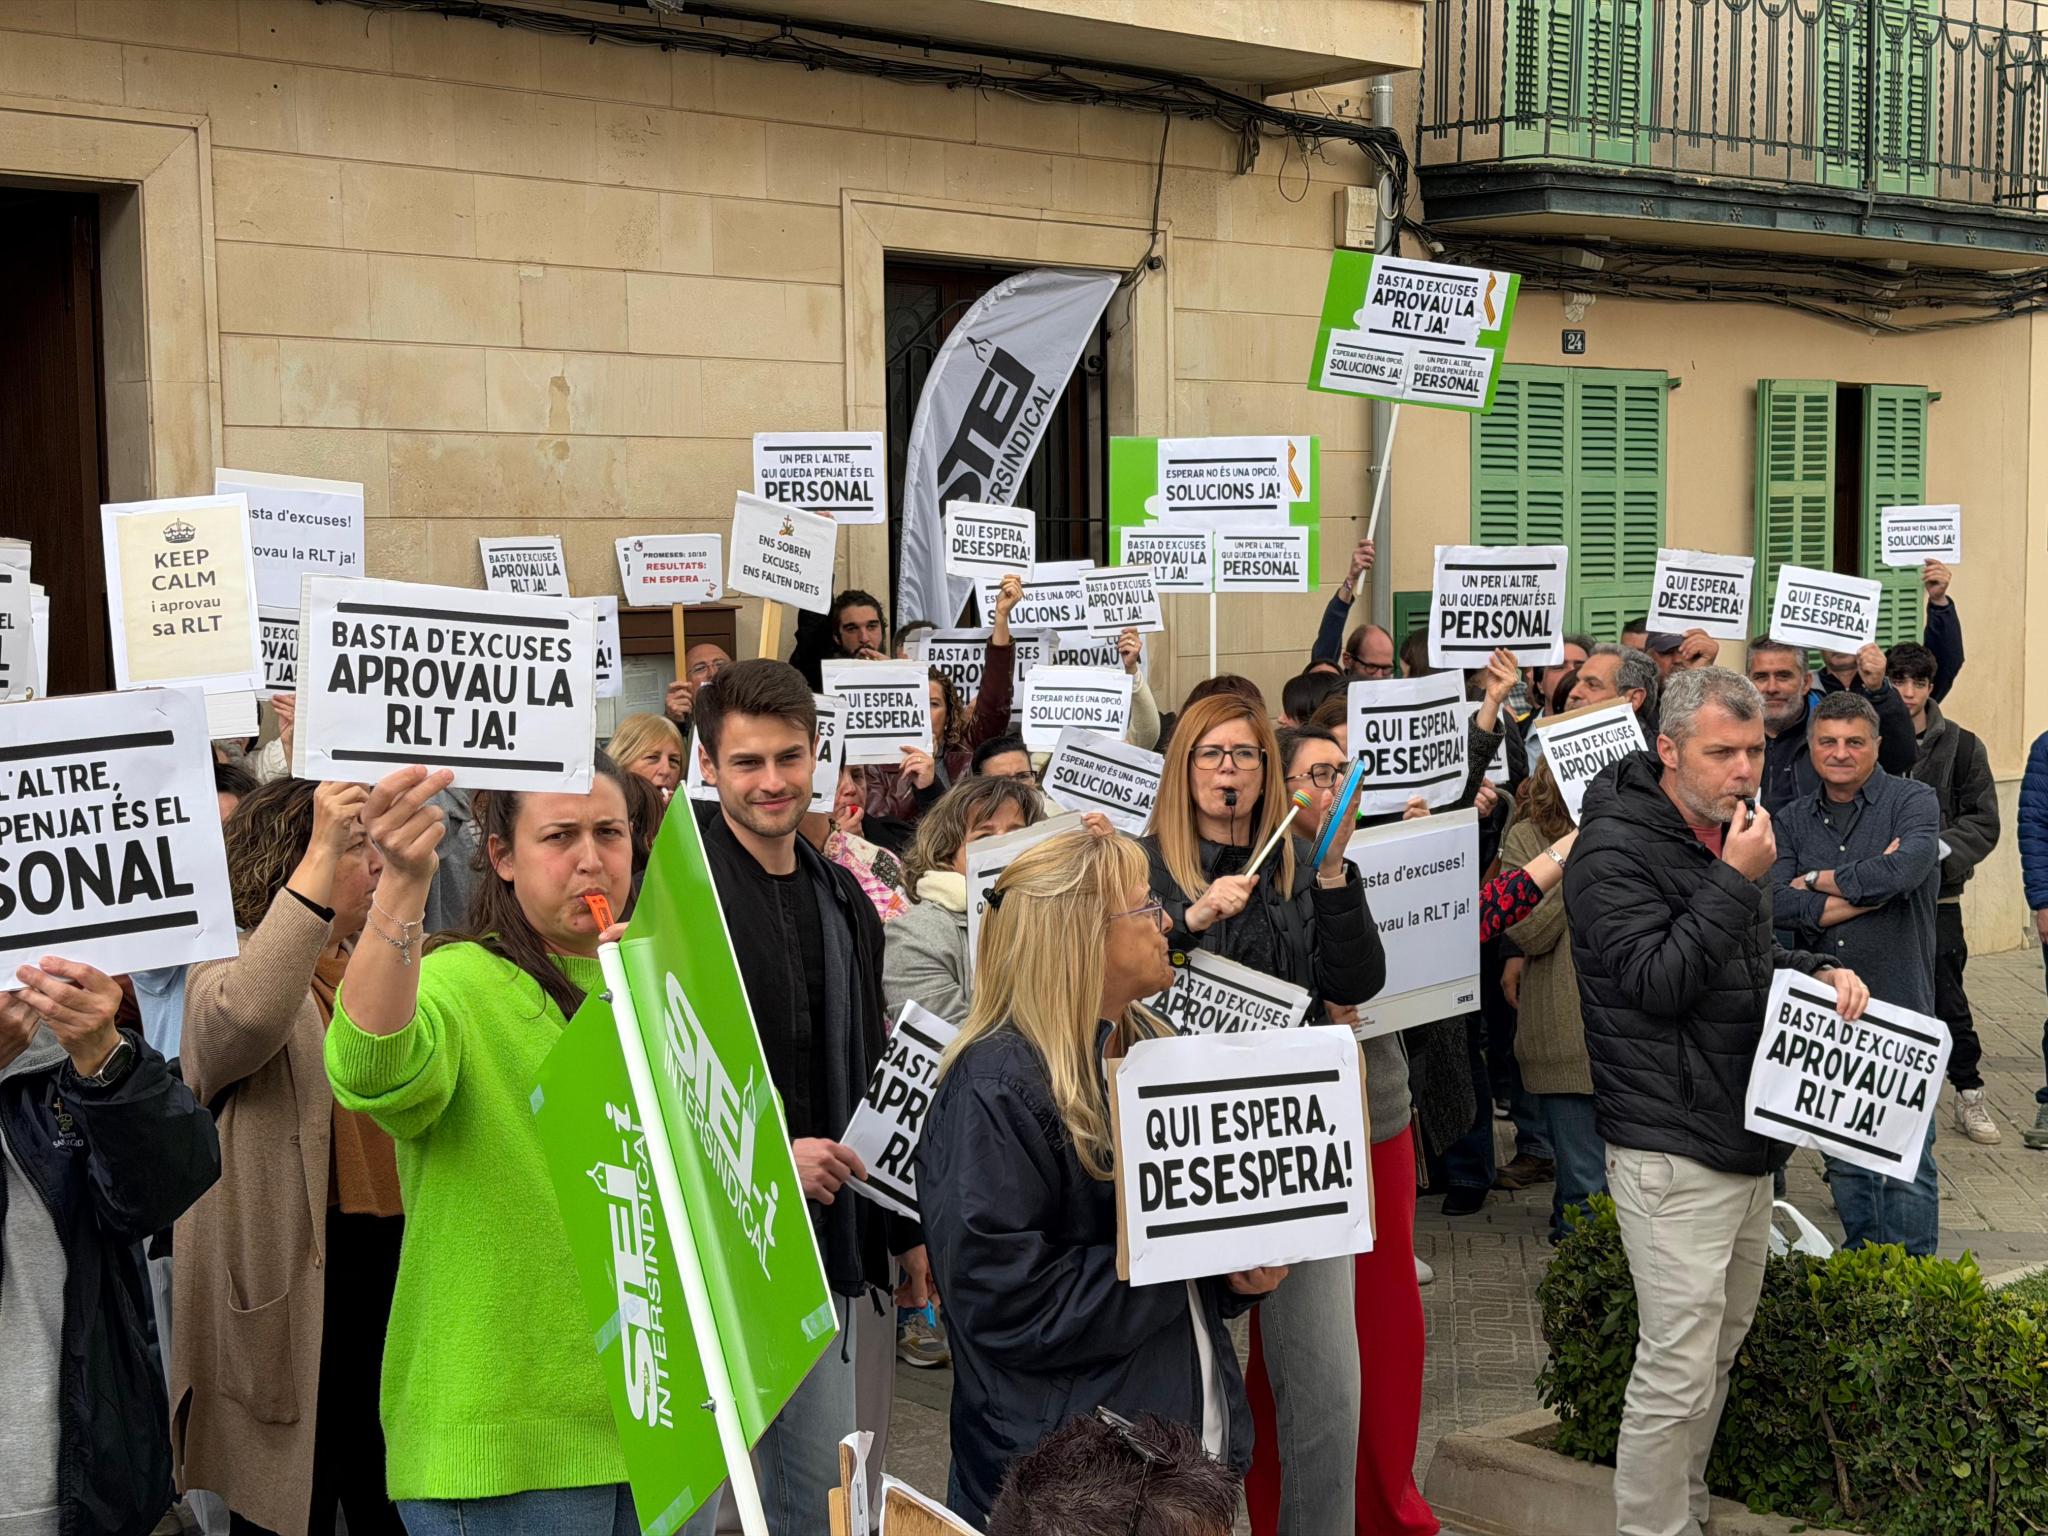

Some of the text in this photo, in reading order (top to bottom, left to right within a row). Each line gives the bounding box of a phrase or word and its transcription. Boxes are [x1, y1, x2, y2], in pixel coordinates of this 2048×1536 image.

[1377, 274, 1478, 298] BASTA D'EXCUSES
[1372, 288, 1475, 318] APROVAU LA
[1392, 311, 1450, 334] RLT JA!
[1568, 334, 1582, 349] 24
[1330, 359, 1402, 379] SOLUCIONS JA!
[1413, 372, 1480, 392] PERSONAL
[780, 454, 854, 464] UN PER L'ALTRE,
[761, 465, 875, 478] QUI QUEDA PENJAT ÉS EL
[1166, 465, 1280, 478] ESPERAR NO ÉS UNA OPCIÓ,
[765, 480, 873, 502] PERSONAL
[1166, 482, 1281, 501] SOLUCIONS JA!
[278, 510, 351, 527] d'excuses!
[956, 524, 1026, 544] QUI ESPERA,
[1888, 534, 1955, 546] SOLUCIONS JA!
[759, 535, 811, 559] ENS SOBREN
[952, 538, 1031, 561] DESESPERA!
[1128, 541, 1155, 550] BASTA
[154, 549, 209, 569] KEEP
[293, 546, 356, 566] la RLT ja!
[489, 553, 557, 563] BASTA D'EXCUSES
[646, 562, 706, 570] RESULTATS:
[762, 553, 802, 574] EXCUSES,
[1127, 551, 1207, 564] APROVAU LA
[492, 563, 561, 578] APROVAU LA
[1171, 566, 1188, 580] JA!
[1223, 561, 1299, 576] PERSONAL
[152, 571, 216, 590] CALM
[510, 578, 547, 593] RLT JA!
[660, 575, 698, 583] ESPERA
[743, 564, 820, 596] ENS FALTEN DRETS
[1086, 583, 1108, 592] BASTA
[1462, 574, 1541, 588] UN PER L'ALTRE,
[1666, 575, 1740, 596] QUI ESPERA,
[1036, 590, 1045, 601] ÉS
[1047, 591, 1063, 600] UNA
[1088, 589, 1155, 608] APROVAU LA
[1440, 589, 1556, 607] QUI QUEDA PENJAT ÉS EL
[1658, 591, 1743, 616] DESESPERA!
[1788, 589, 1865, 616] QUI ESPERA,
[152, 598, 221, 614] i aprovau
[1103, 606, 1142, 622] RLT JA!
[153, 615, 222, 636] sa RLT
[1441, 610, 1552, 639] PERSONAL
[1780, 604, 1869, 634] DESESPERA!
[332, 621, 419, 652] BASTA
[428, 628, 572, 662] D'EXCUSES
[929, 648, 970, 661] BASTA
[328, 654, 517, 704] APROVAU
[527, 667, 574, 707] LA
[864, 692, 918, 708] ESPERA,
[1031, 694, 1062, 702] ESPERAR
[1075, 693, 1084, 703] ÉS
[1086, 695, 1100, 704] UNA
[846, 710, 925, 729] ESESPERA!
[1030, 706, 1123, 724] SOLUCIONS JA!
[386, 704, 516, 750] RLT JA!
[1365, 709, 1459, 744] QUI ESPERA,
[1551, 725, 1635, 760] BASTA D'EXCUSES
[1359, 735, 1465, 776] DESESPERA!
[1060, 753, 1094, 770] ESPERAR
[1095, 762, 1106, 774] NO
[1108, 763, 1118, 777] ÉS
[1119, 770, 1133, 782] UNA
[1054, 766, 1155, 810] SOLUCIONS JA!
[112, 793, 149, 831] ÉS
[155, 796, 190, 827] EL
[1394, 852, 1465, 883] d'excuses!
[1408, 897, 1470, 927] la RLT ja!
[1174, 975, 1290, 1028] ASTA D'EXCUSES
[1778, 1002, 1938, 1074] BASTA D'EXCUSES
[1766, 1030, 1927, 1112] APROVAU LA
[1794, 1079, 1886, 1138] RLT JA!
[1146, 1094, 1337, 1151] QUI ESPERA,
[663, 1039, 771, 1281] INTERSINDICAL
[1138, 1140, 1353, 1212] DESESPERA!
[631, 1123, 674, 1430] INTERSINDICAL
